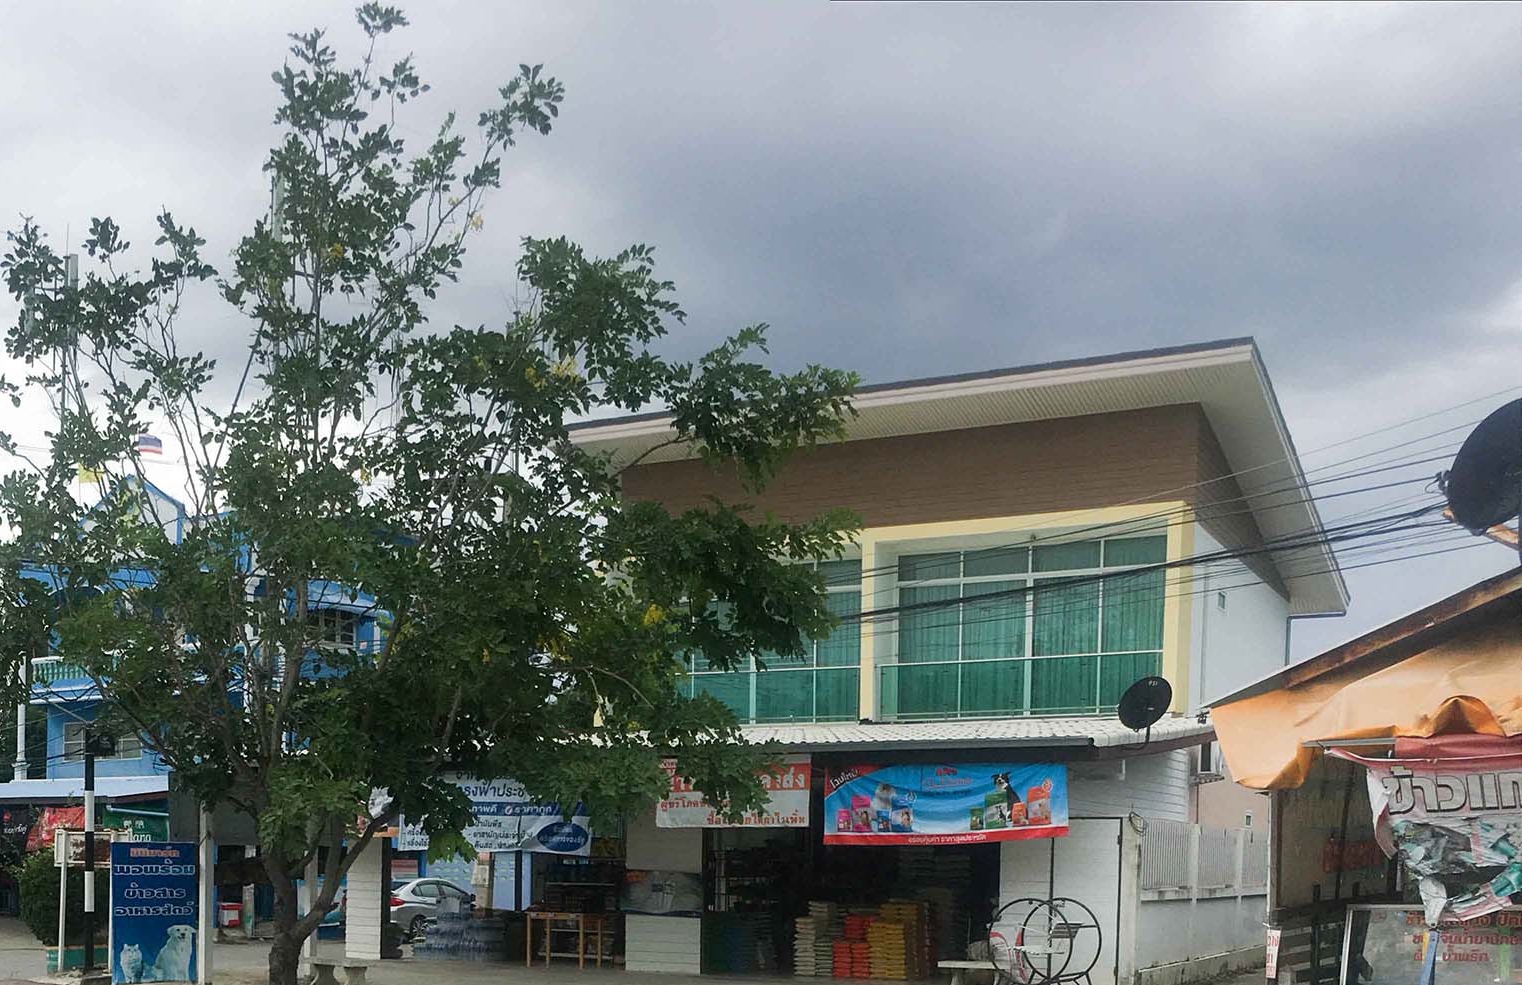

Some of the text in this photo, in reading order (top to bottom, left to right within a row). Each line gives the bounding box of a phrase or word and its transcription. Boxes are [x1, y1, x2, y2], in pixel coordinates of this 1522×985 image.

[113, 858, 195, 876] พอพร้อม
[125, 881, 186, 899] ข้าวสาร
[114, 901, 195, 916] อาหารสัตว์
